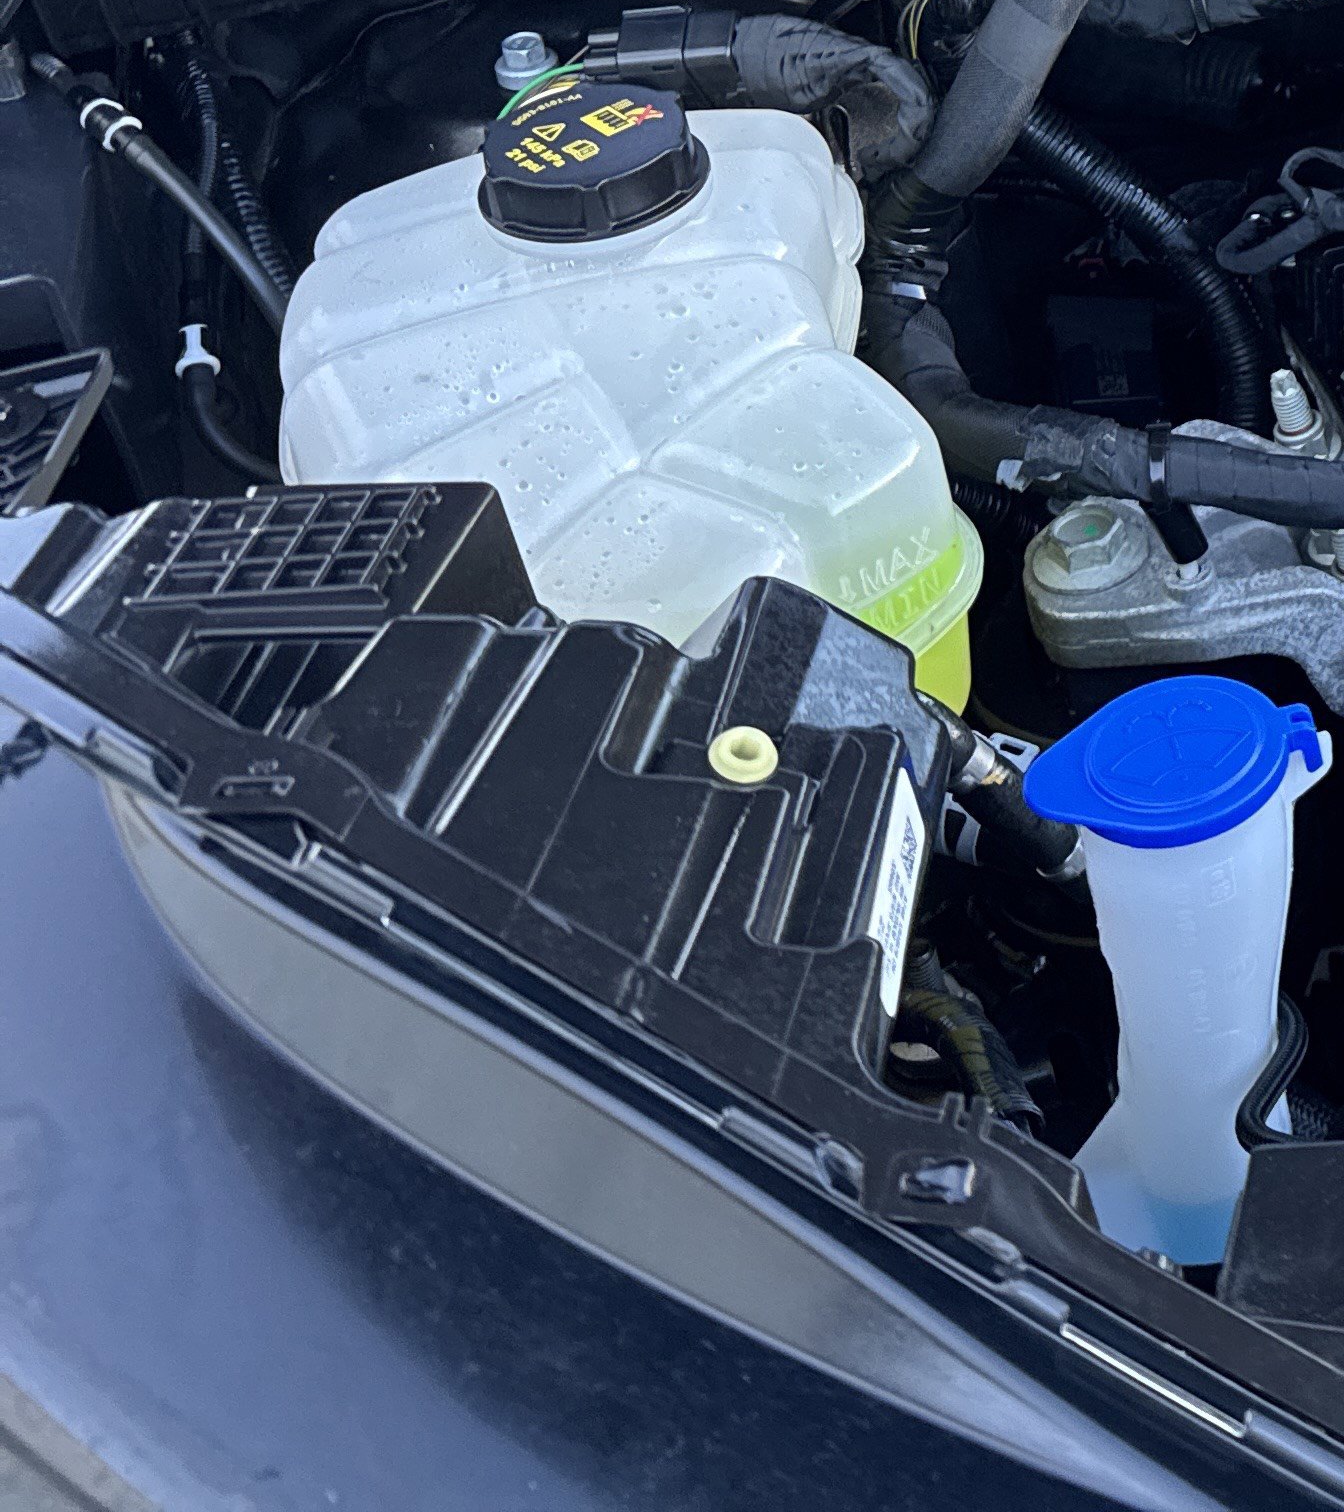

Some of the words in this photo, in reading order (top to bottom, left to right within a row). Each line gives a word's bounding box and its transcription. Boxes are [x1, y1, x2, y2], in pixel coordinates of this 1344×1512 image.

[505, 148, 527, 162] 21
[860, 527, 938, 597] MAX
[870, 568, 940, 629] MIN
